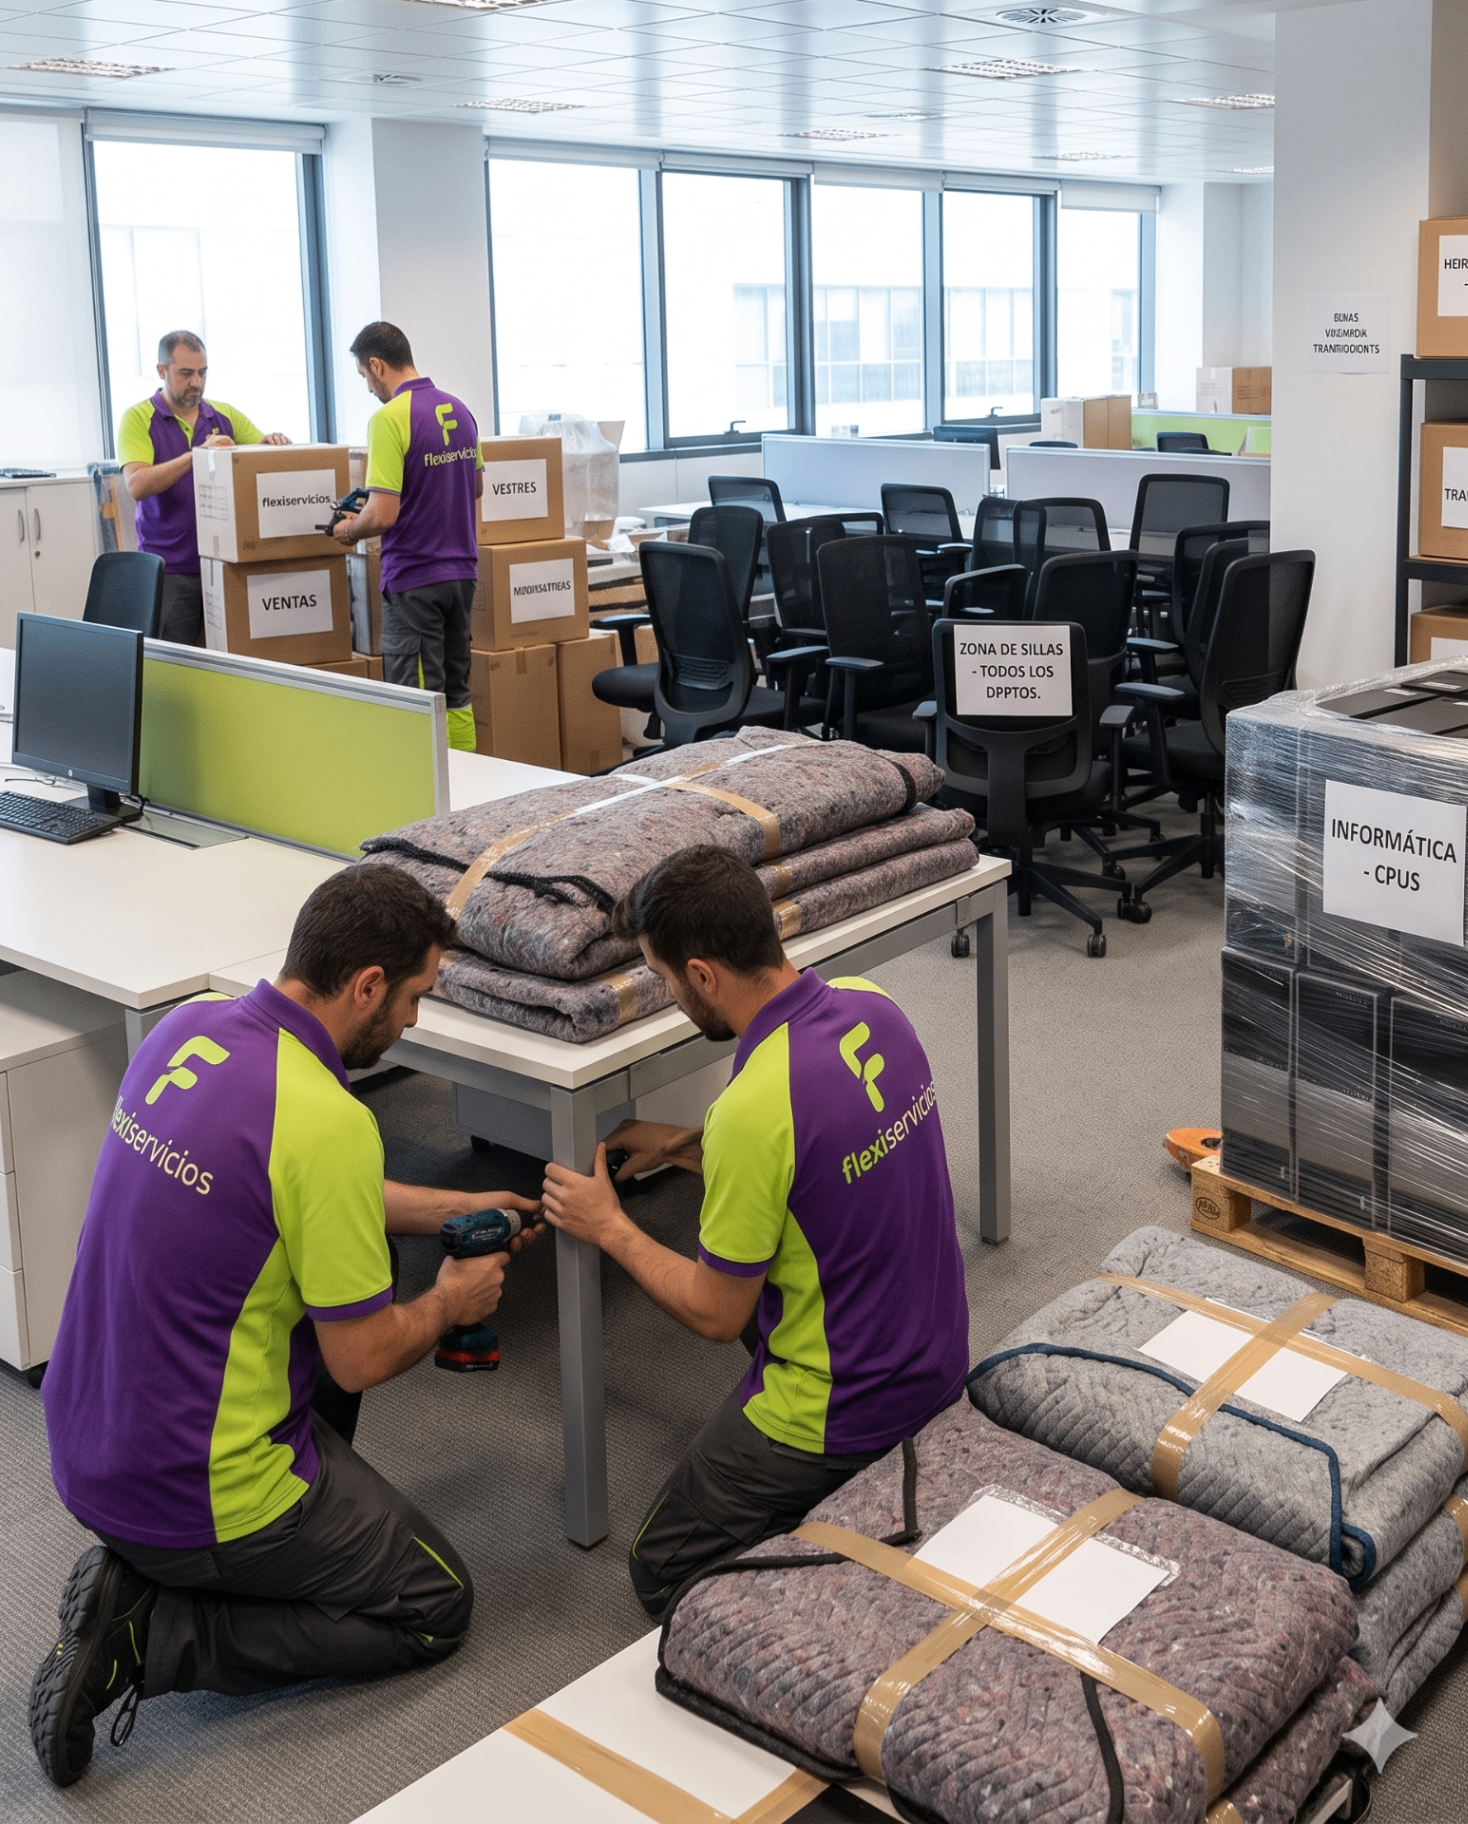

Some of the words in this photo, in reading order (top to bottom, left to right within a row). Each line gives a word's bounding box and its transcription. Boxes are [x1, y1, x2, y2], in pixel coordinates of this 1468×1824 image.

[262, 494, 331, 507] flexiservicios
[1444, 488, 1468, 501] TRA
[262, 594, 317, 611] VENTAS
[959, 643, 997, 655] ZONA
[1000, 643, 1018, 655] DE
[1021, 643, 1064, 656] SILLAS
[980, 665, 1026, 678] TODOS
[1029, 665, 1054, 678] LOS
[986, 686, 1041, 699] DPPTOS.
[1331, 818, 1457, 864] INFORMÁTICA
[1374, 864, 1420, 892] CPUS
